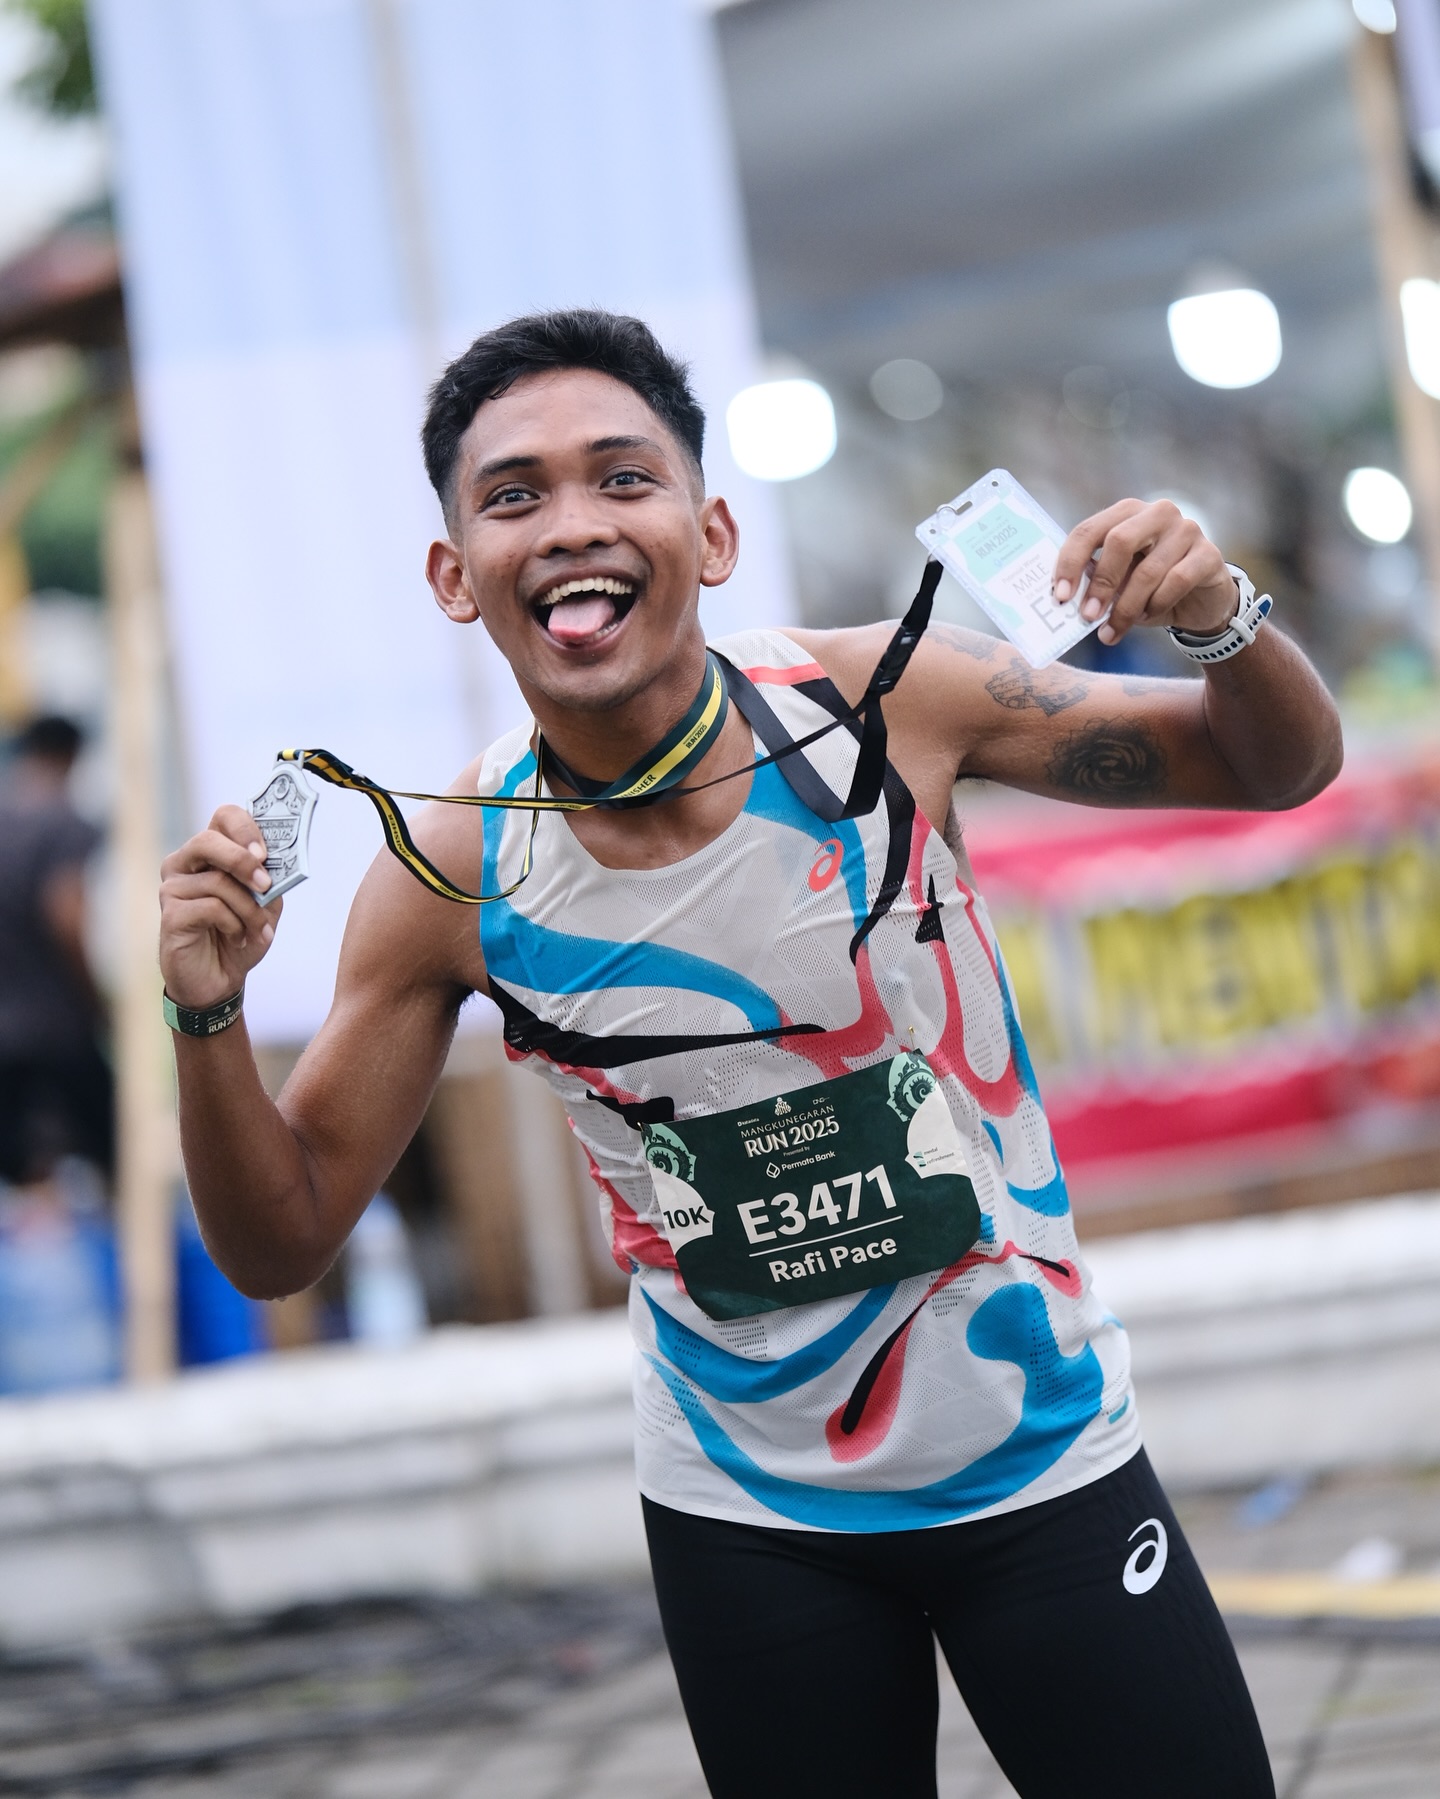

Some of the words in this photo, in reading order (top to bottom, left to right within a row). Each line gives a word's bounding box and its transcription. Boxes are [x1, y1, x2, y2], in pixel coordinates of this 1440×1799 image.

[975, 539, 998, 559] RUN
[994, 525, 1018, 547] 2025
[1012, 563, 1049, 595] MALE
[208, 1020, 226, 1034] RUN
[740, 1104, 835, 1138] MANGKUNEGARAN
[743, 1131, 789, 1158] RUN
[788, 1115, 840, 1145] 2025
[782, 1156, 815, 1171] Permata
[815, 1150, 836, 1162] Bank
[663, 1205, 710, 1229] 10K
[736, 1164, 897, 1244] E3471
[769, 1250, 827, 1283] Rafi
[829, 1238, 898, 1269] Pace
